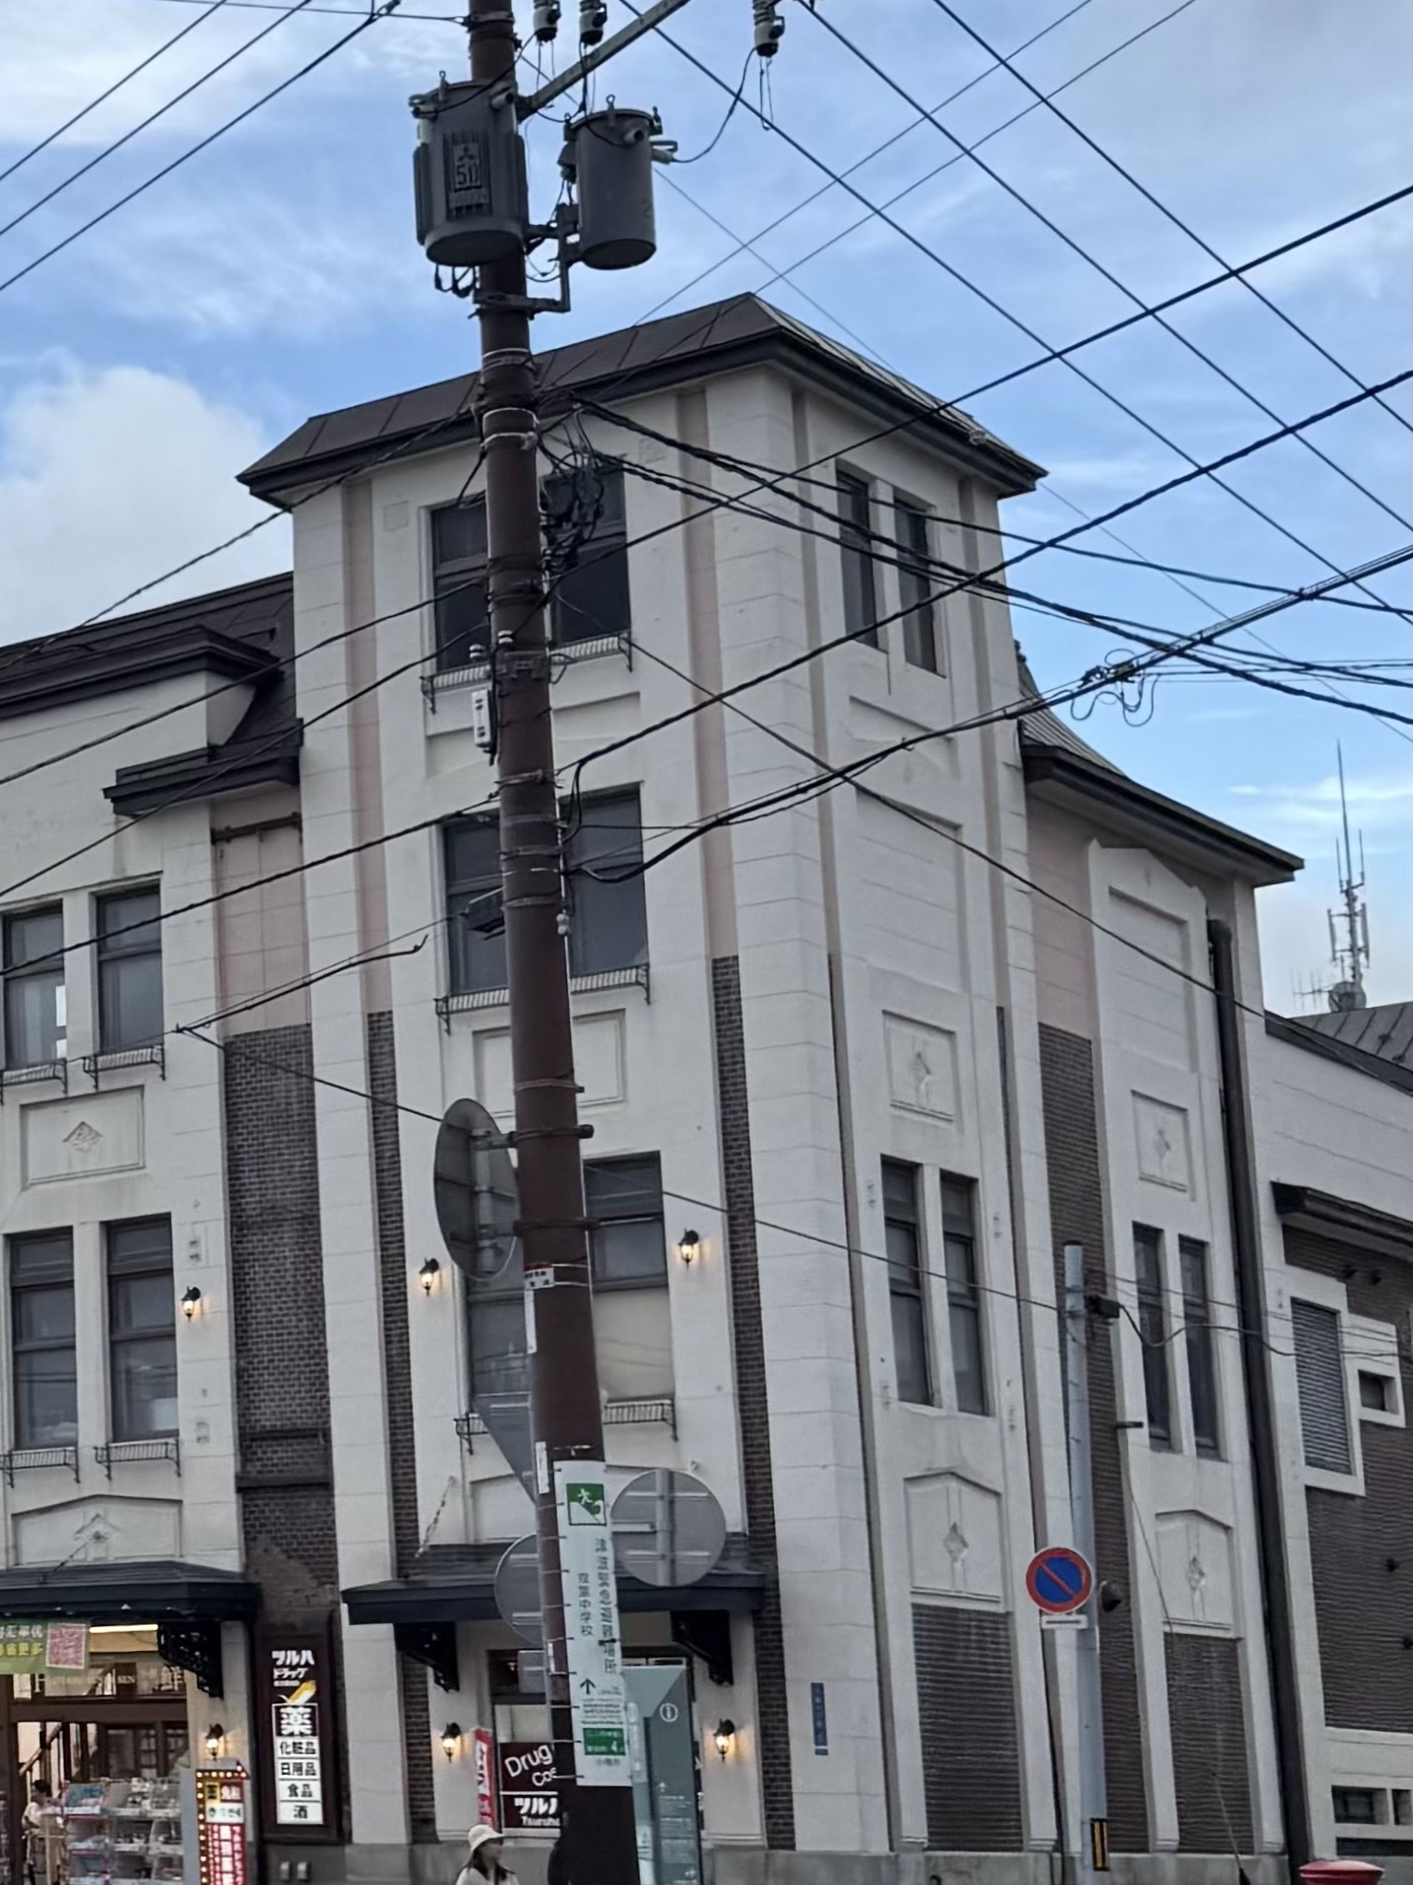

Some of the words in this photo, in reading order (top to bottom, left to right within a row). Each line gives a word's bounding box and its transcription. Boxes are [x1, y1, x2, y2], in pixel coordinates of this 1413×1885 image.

[272, 1650, 315, 1666] ツルハ
[273, 1668, 309, 1679] ドラッグ
[280, 1707, 313, 1735] 薬
[280, 1741, 316, 1755] 化粧品
[504, 1745, 553, 1777] Drug
[280, 1762, 317, 1776] 日用品
[288, 1783, 313, 1798] 食品
[293, 1805, 308, 1819] 酒
